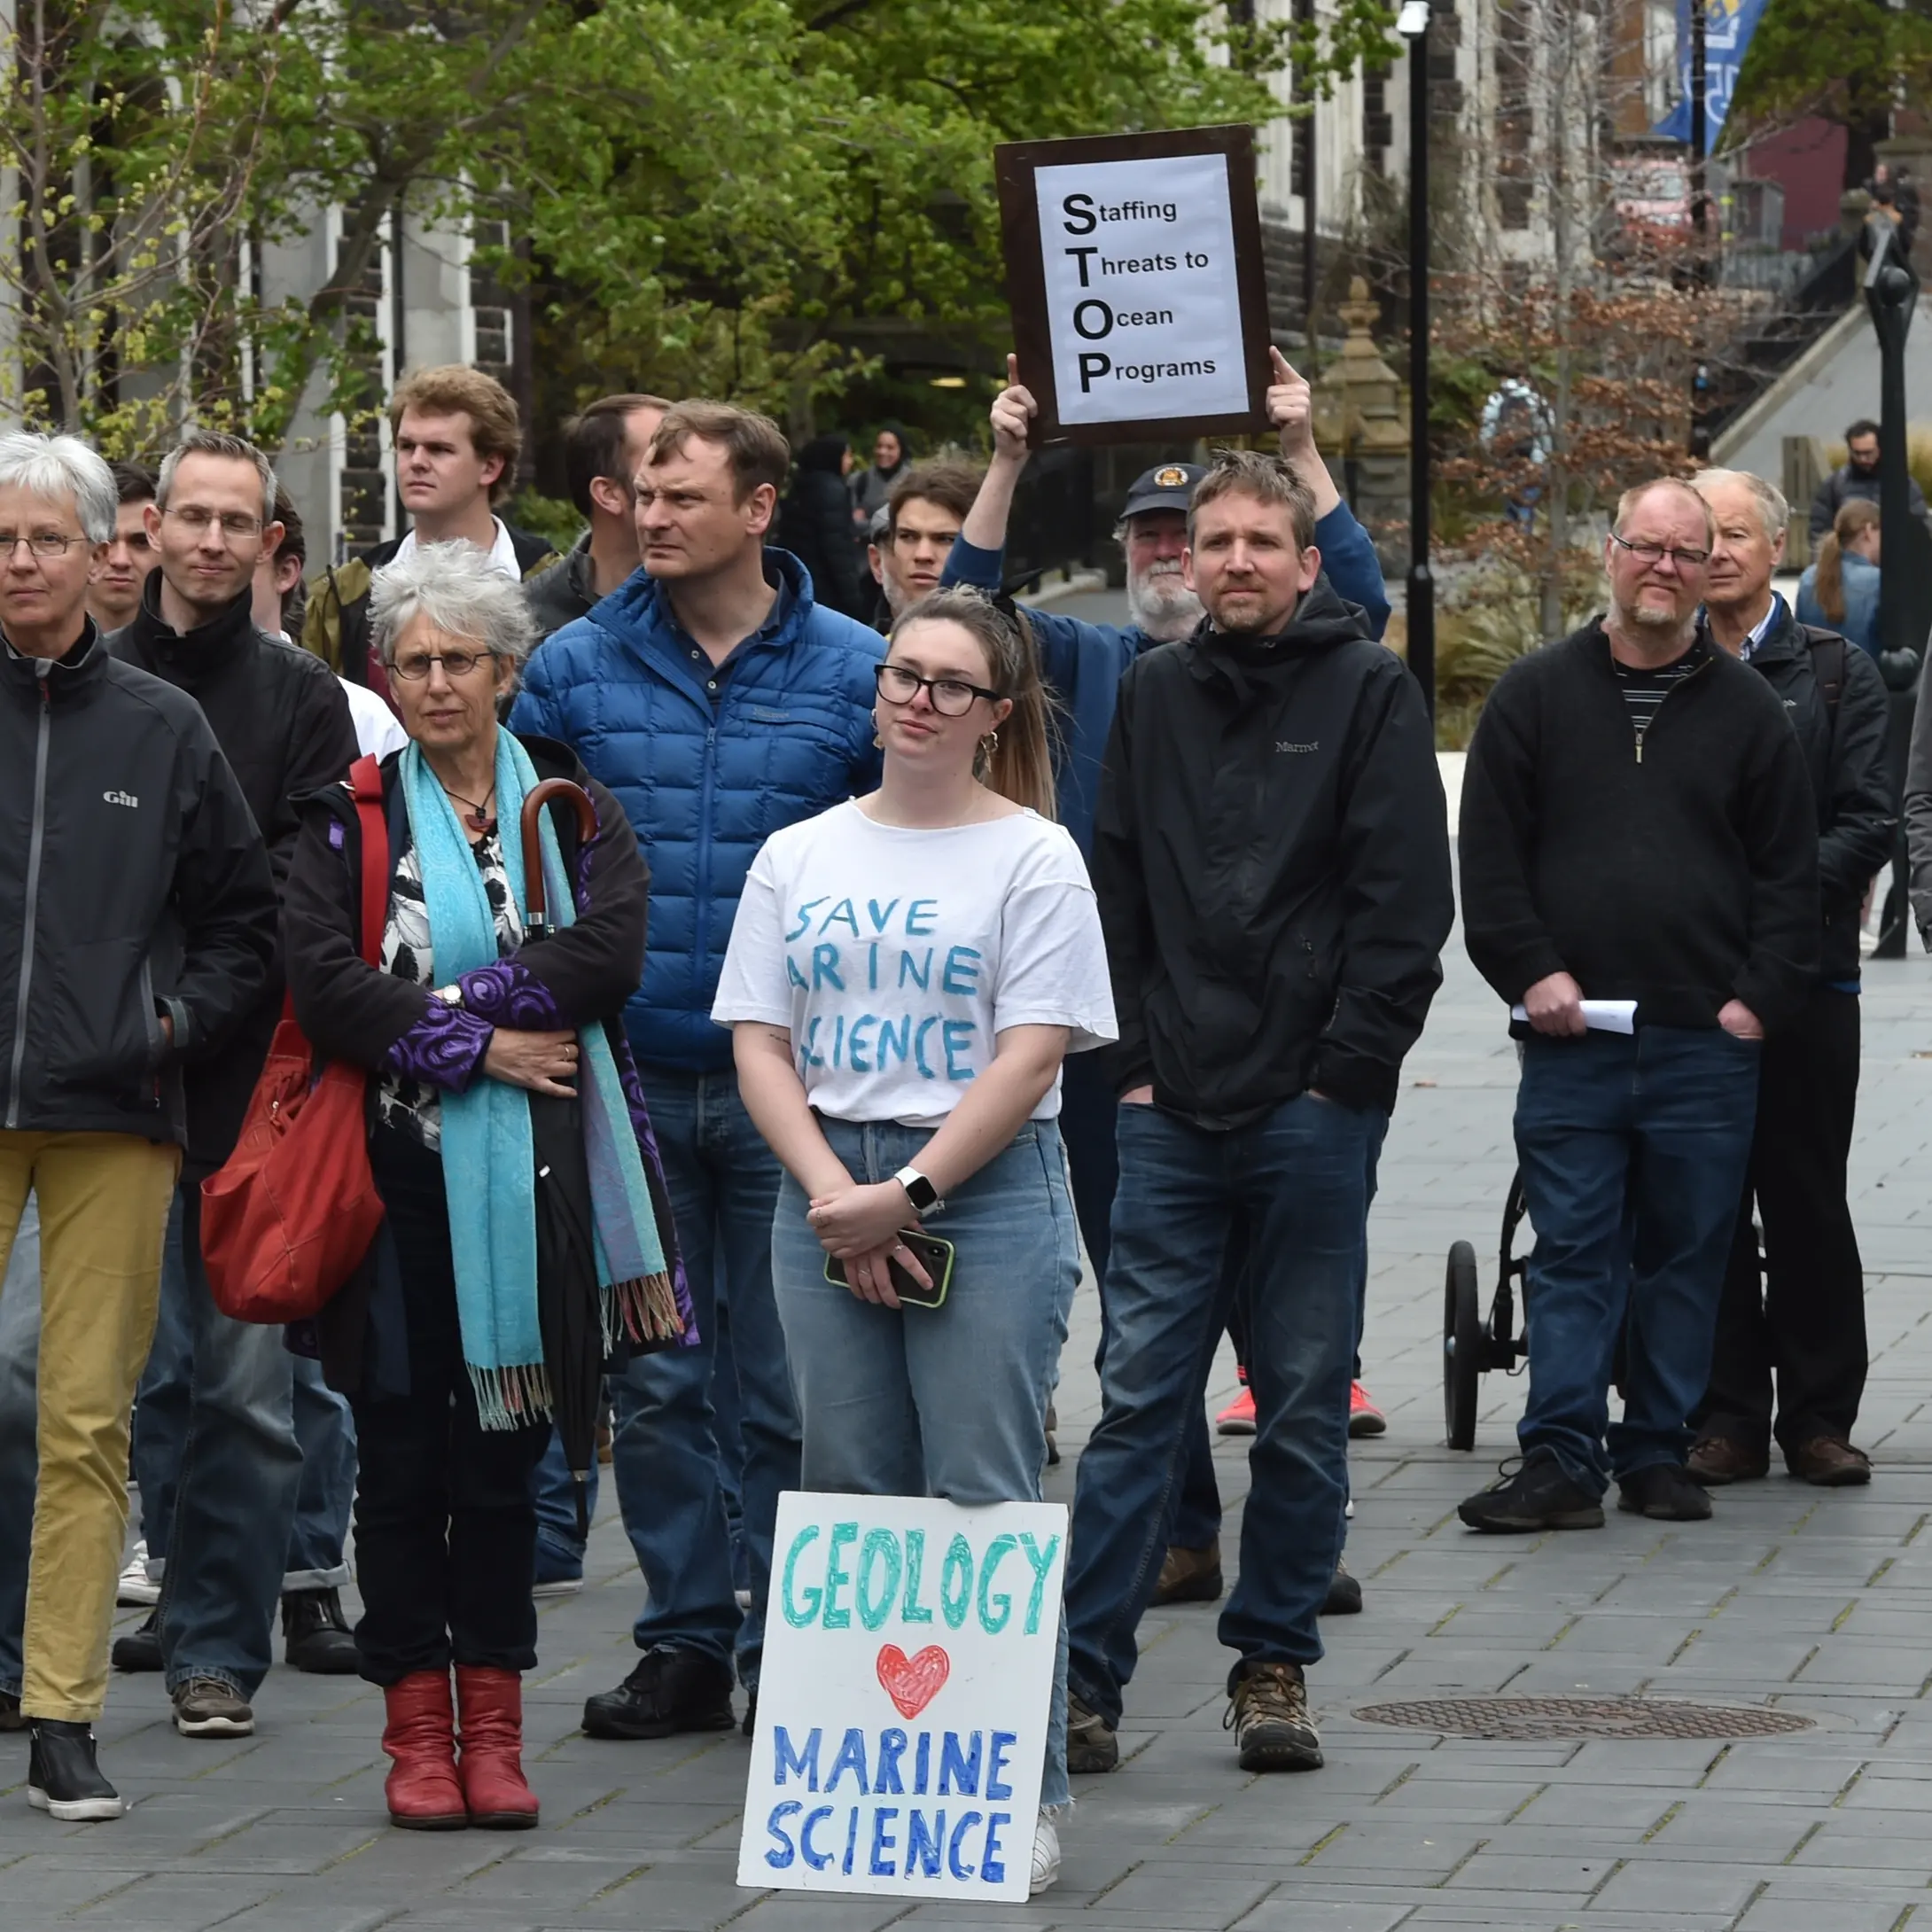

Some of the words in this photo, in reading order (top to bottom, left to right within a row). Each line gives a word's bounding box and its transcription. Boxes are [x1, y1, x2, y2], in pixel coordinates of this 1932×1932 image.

[1063, 193, 1177, 236] Staffing
[1064, 246, 1177, 288] Threats
[1185, 252, 1209, 269] to
[1073, 300, 1173, 340] Ocean
[1078, 352, 1216, 393] Programs
[103, 791, 138, 808] Gill
[785, 895, 939, 943] SAVE
[787, 942, 982, 995] ARINE
[782, 1522, 1062, 1635] GEOLOGY
[774, 1726, 1017, 1801] MARINE
[764, 1800, 1011, 1883] SCIENCE
